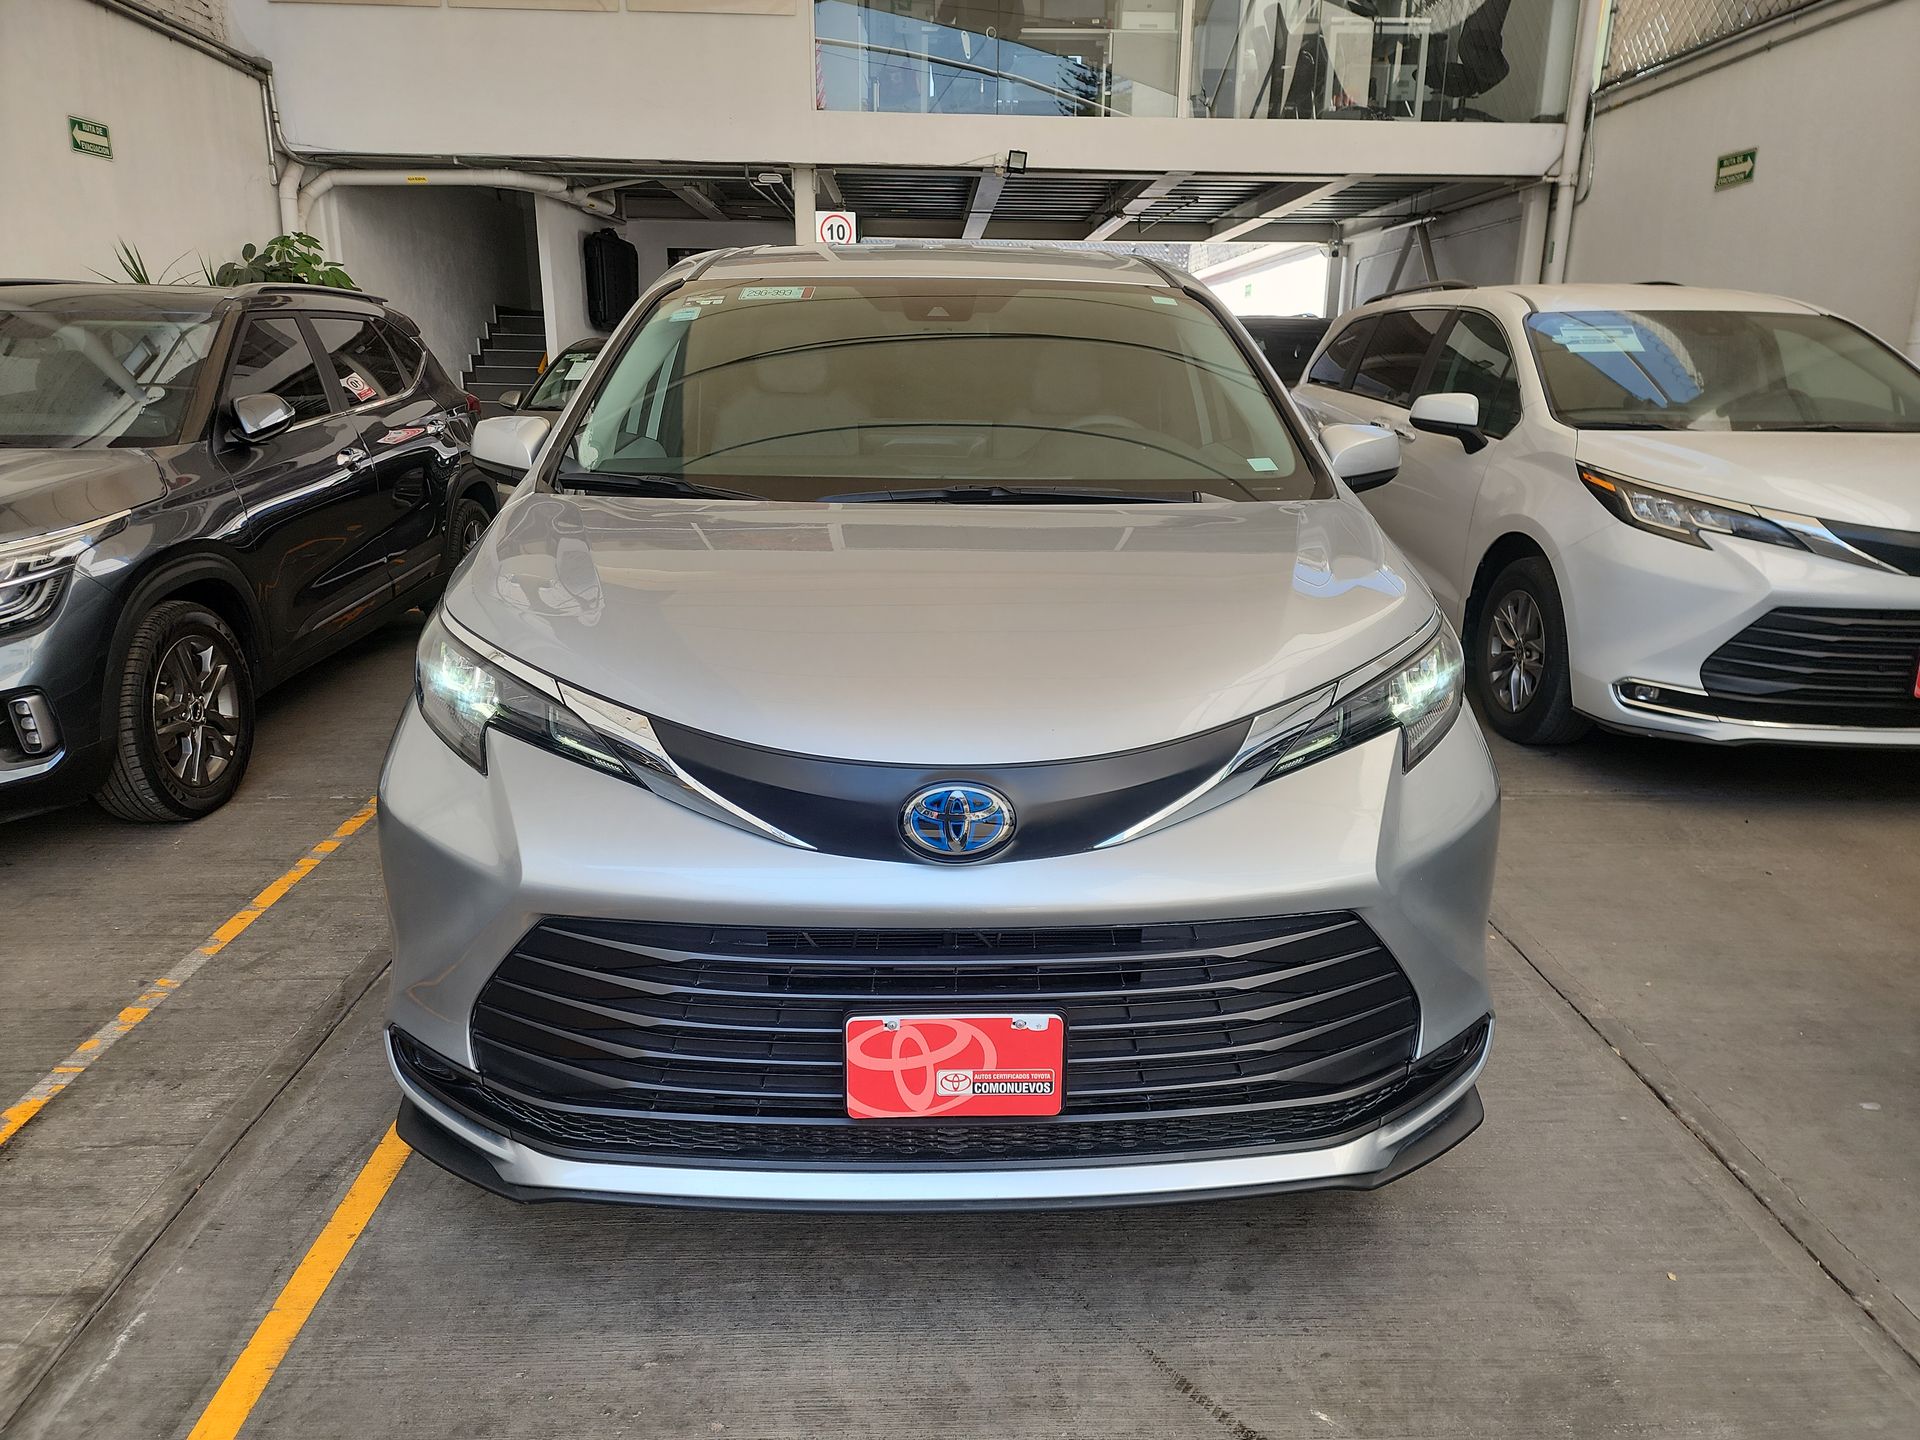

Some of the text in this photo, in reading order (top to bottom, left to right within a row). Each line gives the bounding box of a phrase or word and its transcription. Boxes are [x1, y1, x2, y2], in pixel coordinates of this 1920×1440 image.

[82, 122, 104, 136] RUTA DE
[827, 223, 846, 241] 10
[974, 1082, 1051, 1094] COMONUEVOS
